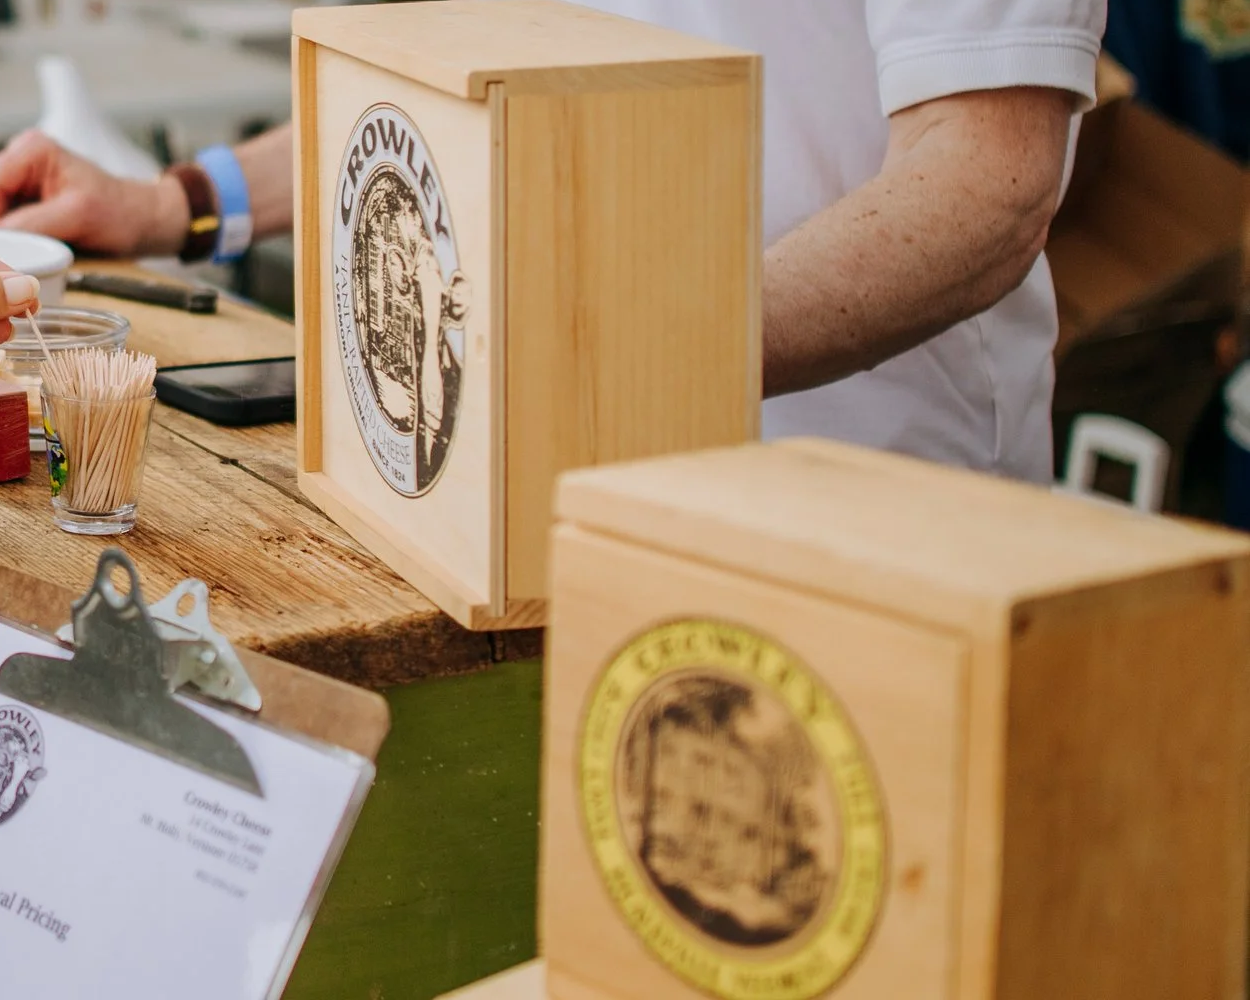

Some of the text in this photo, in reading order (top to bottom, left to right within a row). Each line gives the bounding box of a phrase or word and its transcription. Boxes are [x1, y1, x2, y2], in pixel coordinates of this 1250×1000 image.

[341, 118, 449, 239] CROWLEY
[336, 282, 349, 360] VERMONT
[376, 424, 412, 466] CHEESE
[16, 898, 72, 943] Pricing
